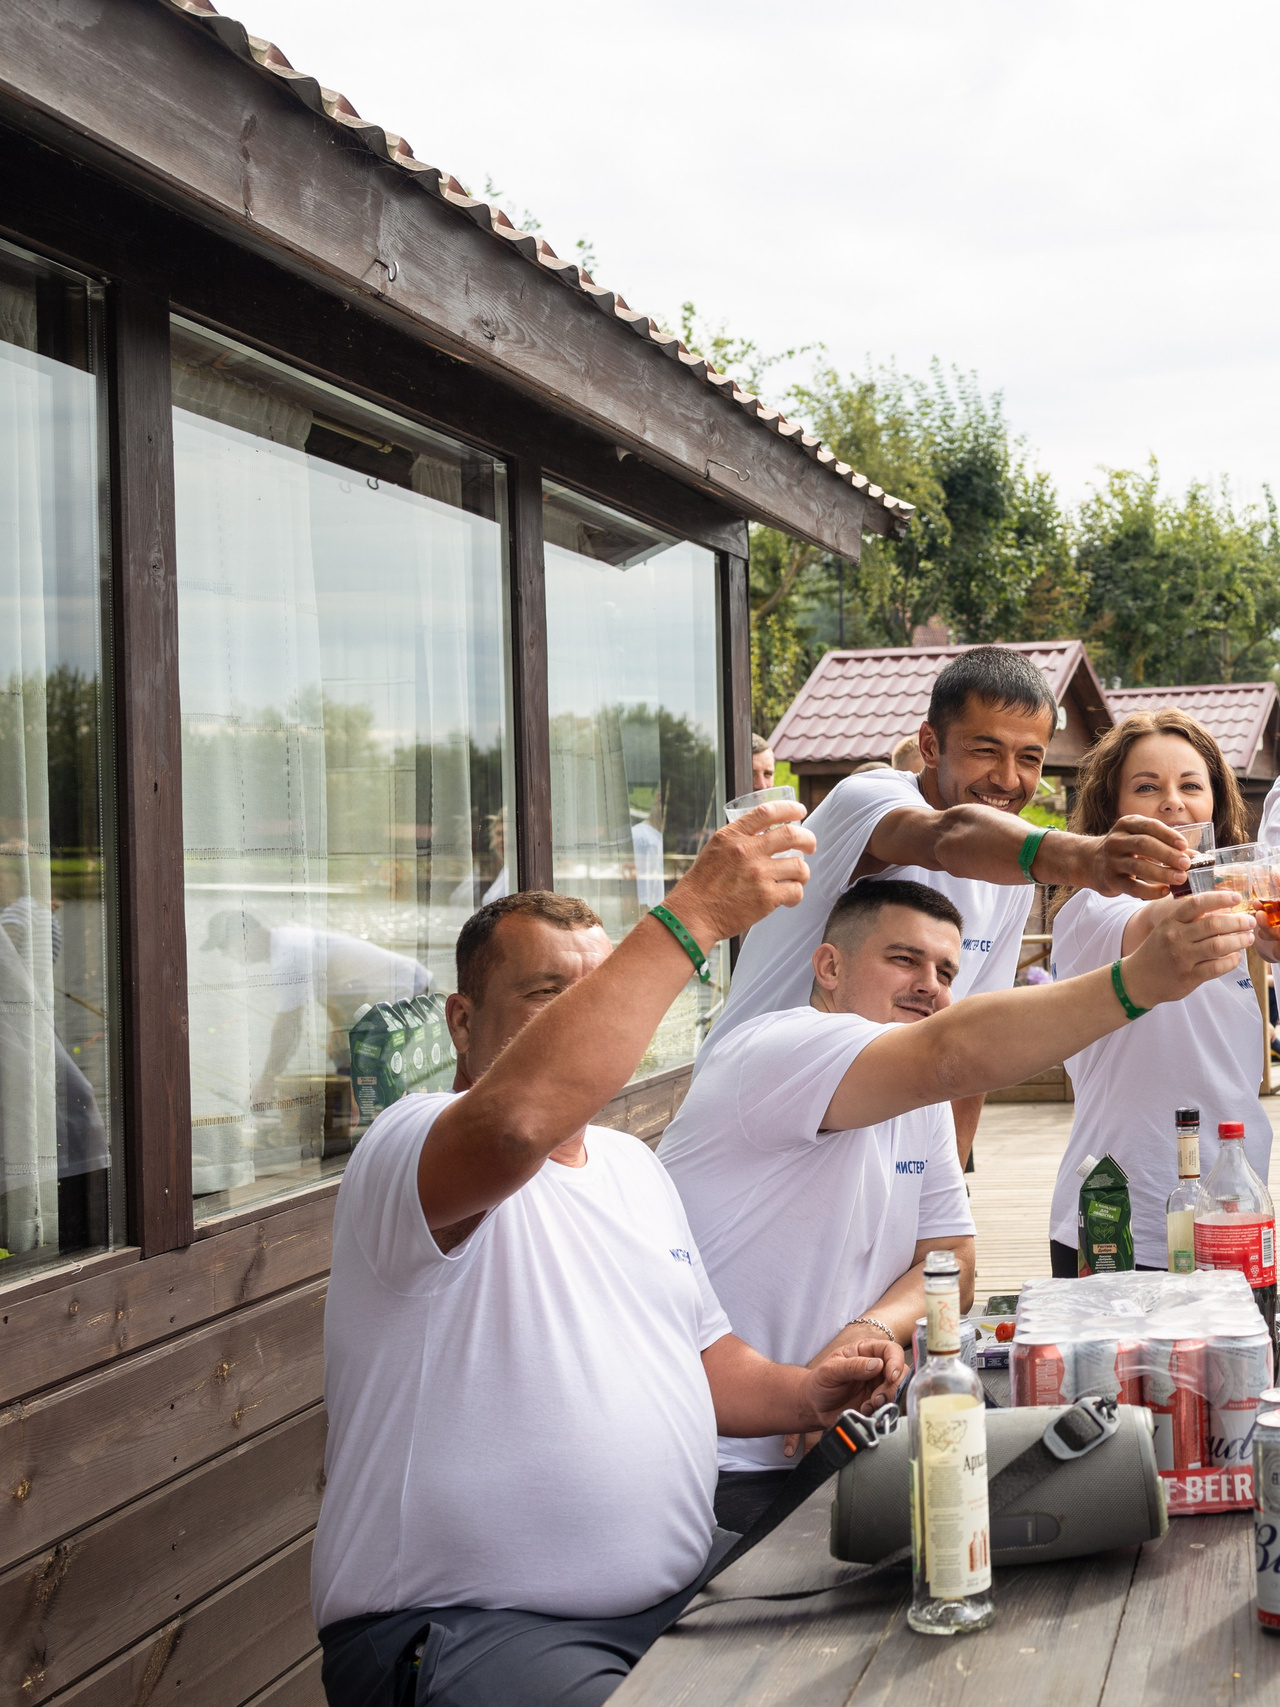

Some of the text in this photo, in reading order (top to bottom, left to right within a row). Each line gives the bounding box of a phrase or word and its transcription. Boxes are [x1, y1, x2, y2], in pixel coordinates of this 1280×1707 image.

[980, 939, 993, 953] СЕ
[895, 1160, 925, 1175] МИСТЕР
[1208, 1422, 1257, 1462] ud
[1186, 1473, 1254, 1504] BEER
